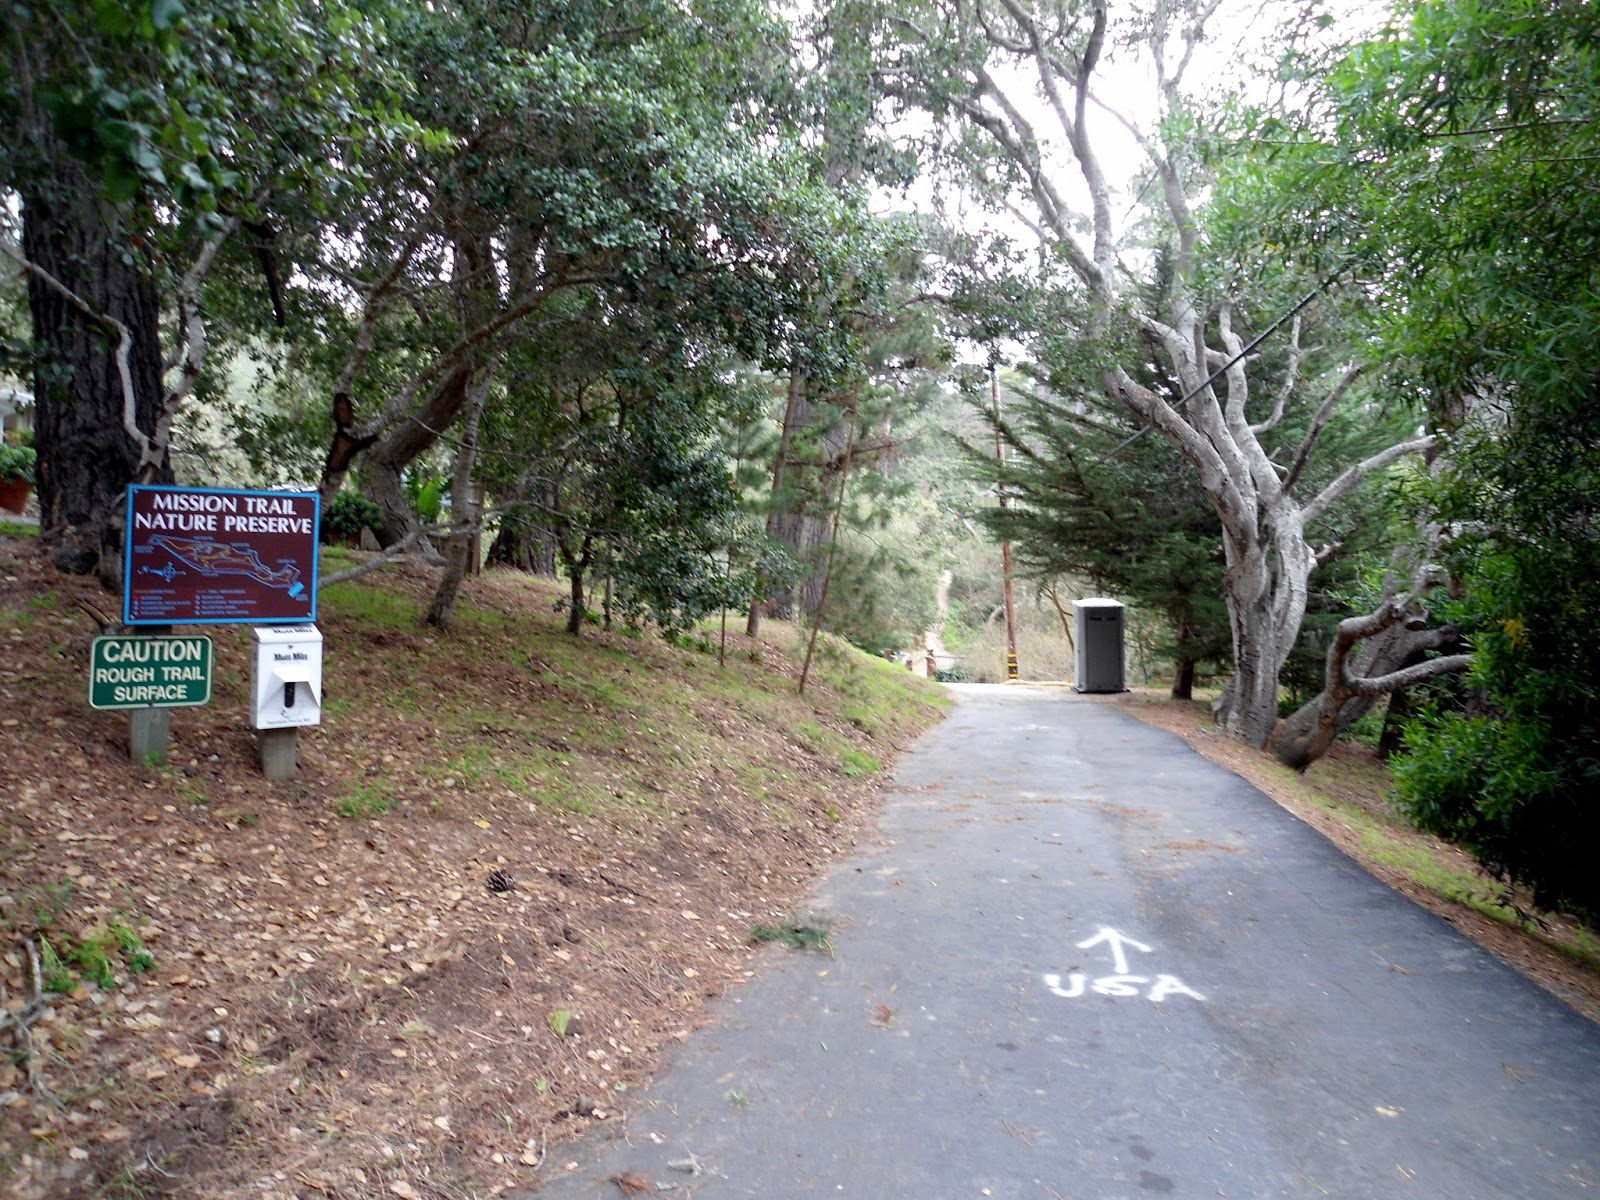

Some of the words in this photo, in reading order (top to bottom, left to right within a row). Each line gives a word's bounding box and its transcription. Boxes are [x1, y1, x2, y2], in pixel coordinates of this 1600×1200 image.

[153, 493, 237, 513] MISSION
[245, 497, 298, 516] TRAIL
[135, 512, 218, 532] NATURE
[224, 516, 312, 534] PRESERVE
[103, 640, 202, 663] CAUTION
[96, 667, 155, 683] ROUGH
[161, 666, 206, 681] TRAIL
[114, 685, 188, 702] SURFACE
[1044, 973, 1207, 1002] USA
